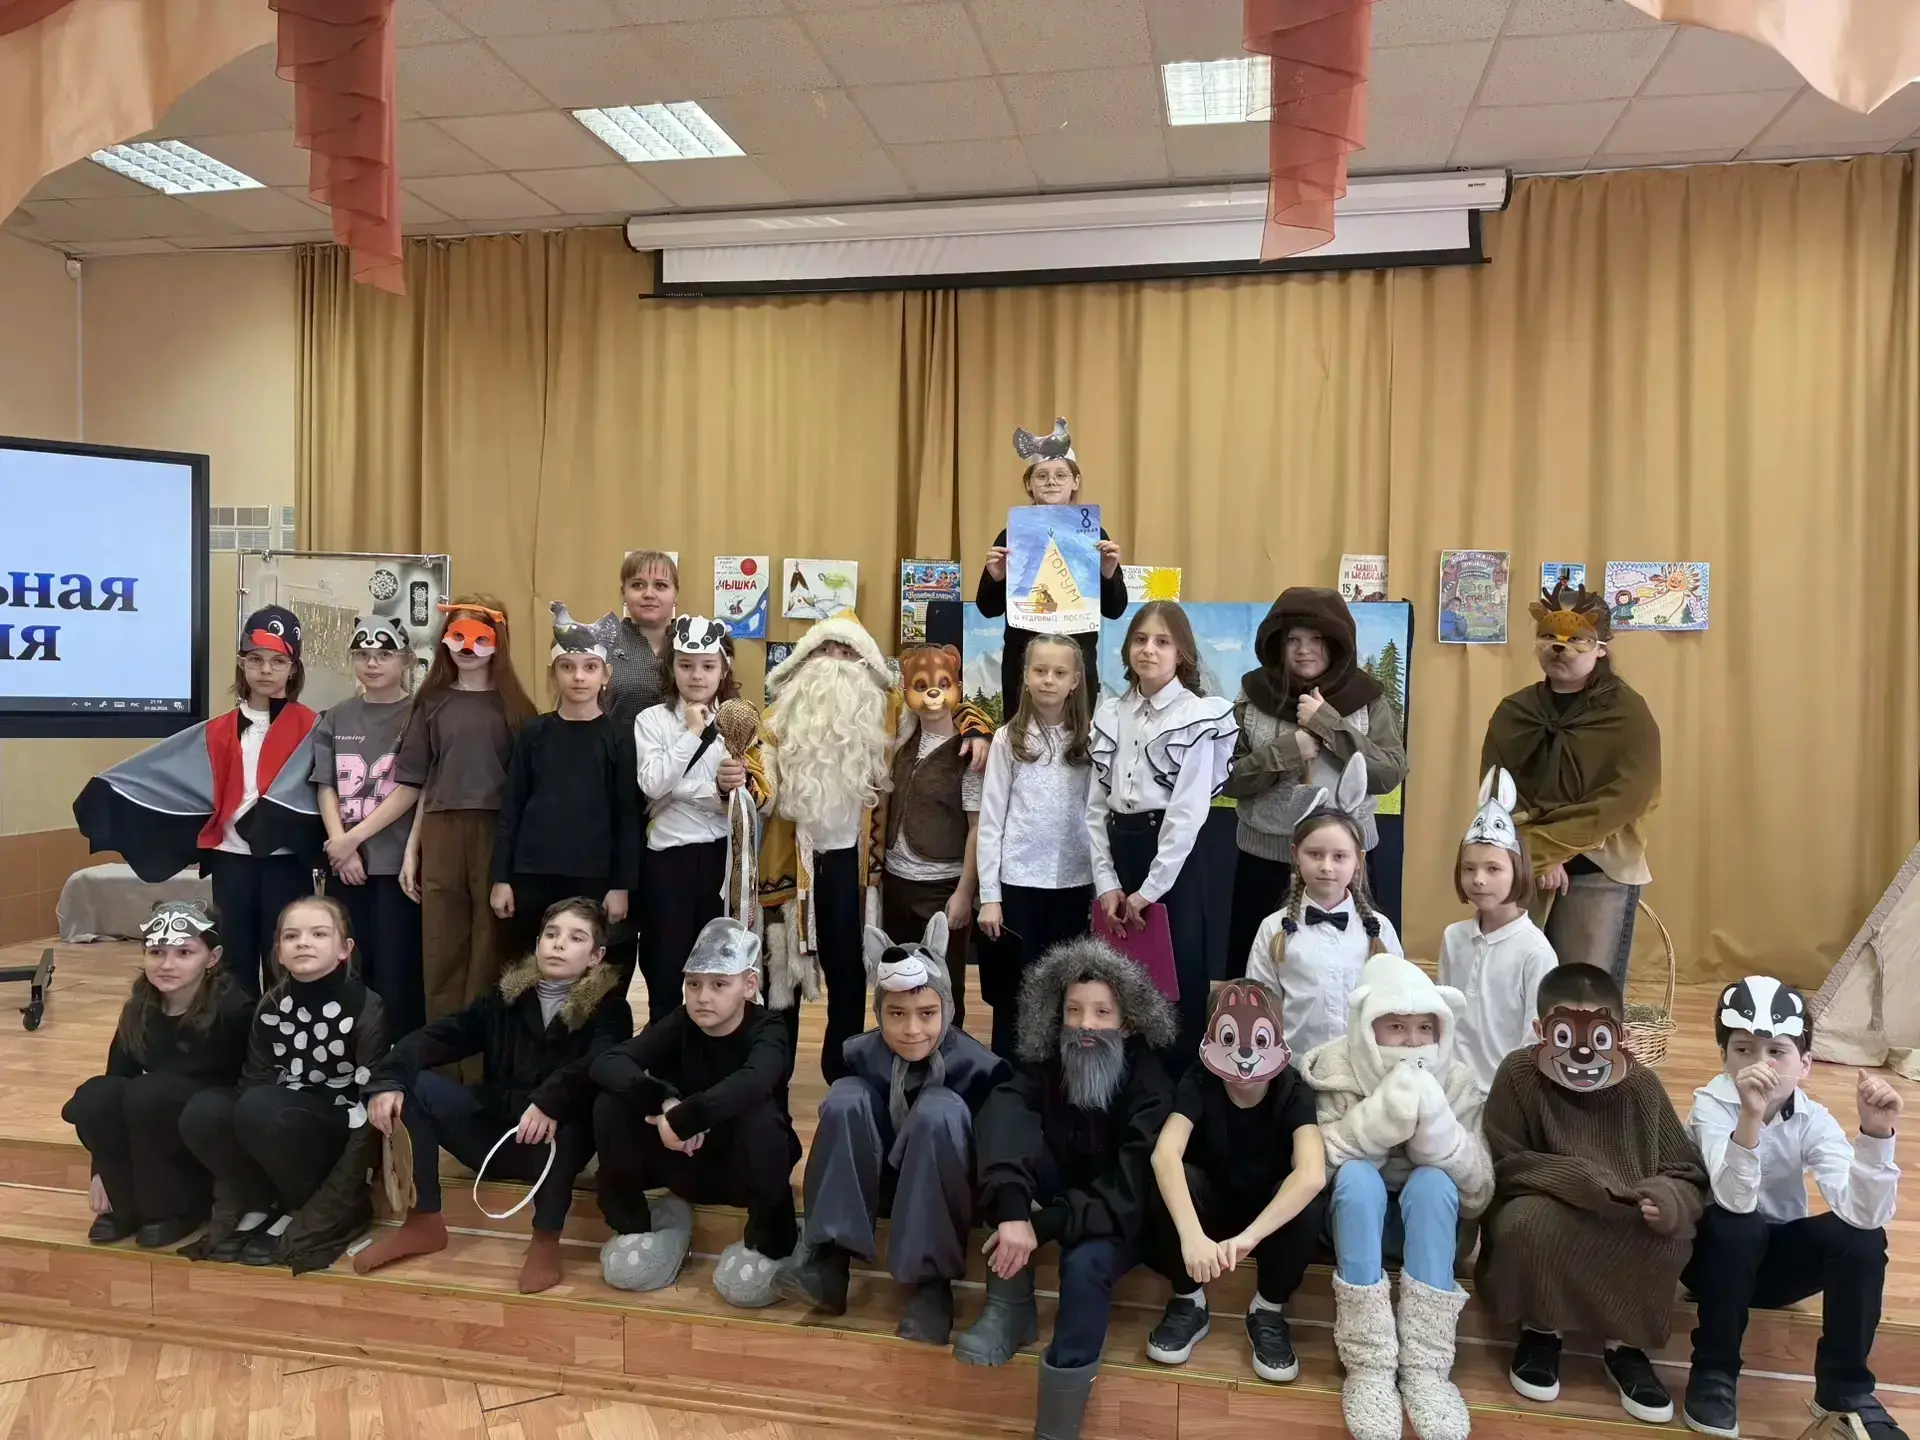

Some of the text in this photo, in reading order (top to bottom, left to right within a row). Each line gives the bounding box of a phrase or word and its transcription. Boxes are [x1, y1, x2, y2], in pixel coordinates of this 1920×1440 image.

[1081, 508, 1091, 528] 8
[1048, 549, 1080, 603] ТОРУМ
[716, 579, 757, 590] МЫШКА
[1342, 583, 1351, 594] 15
